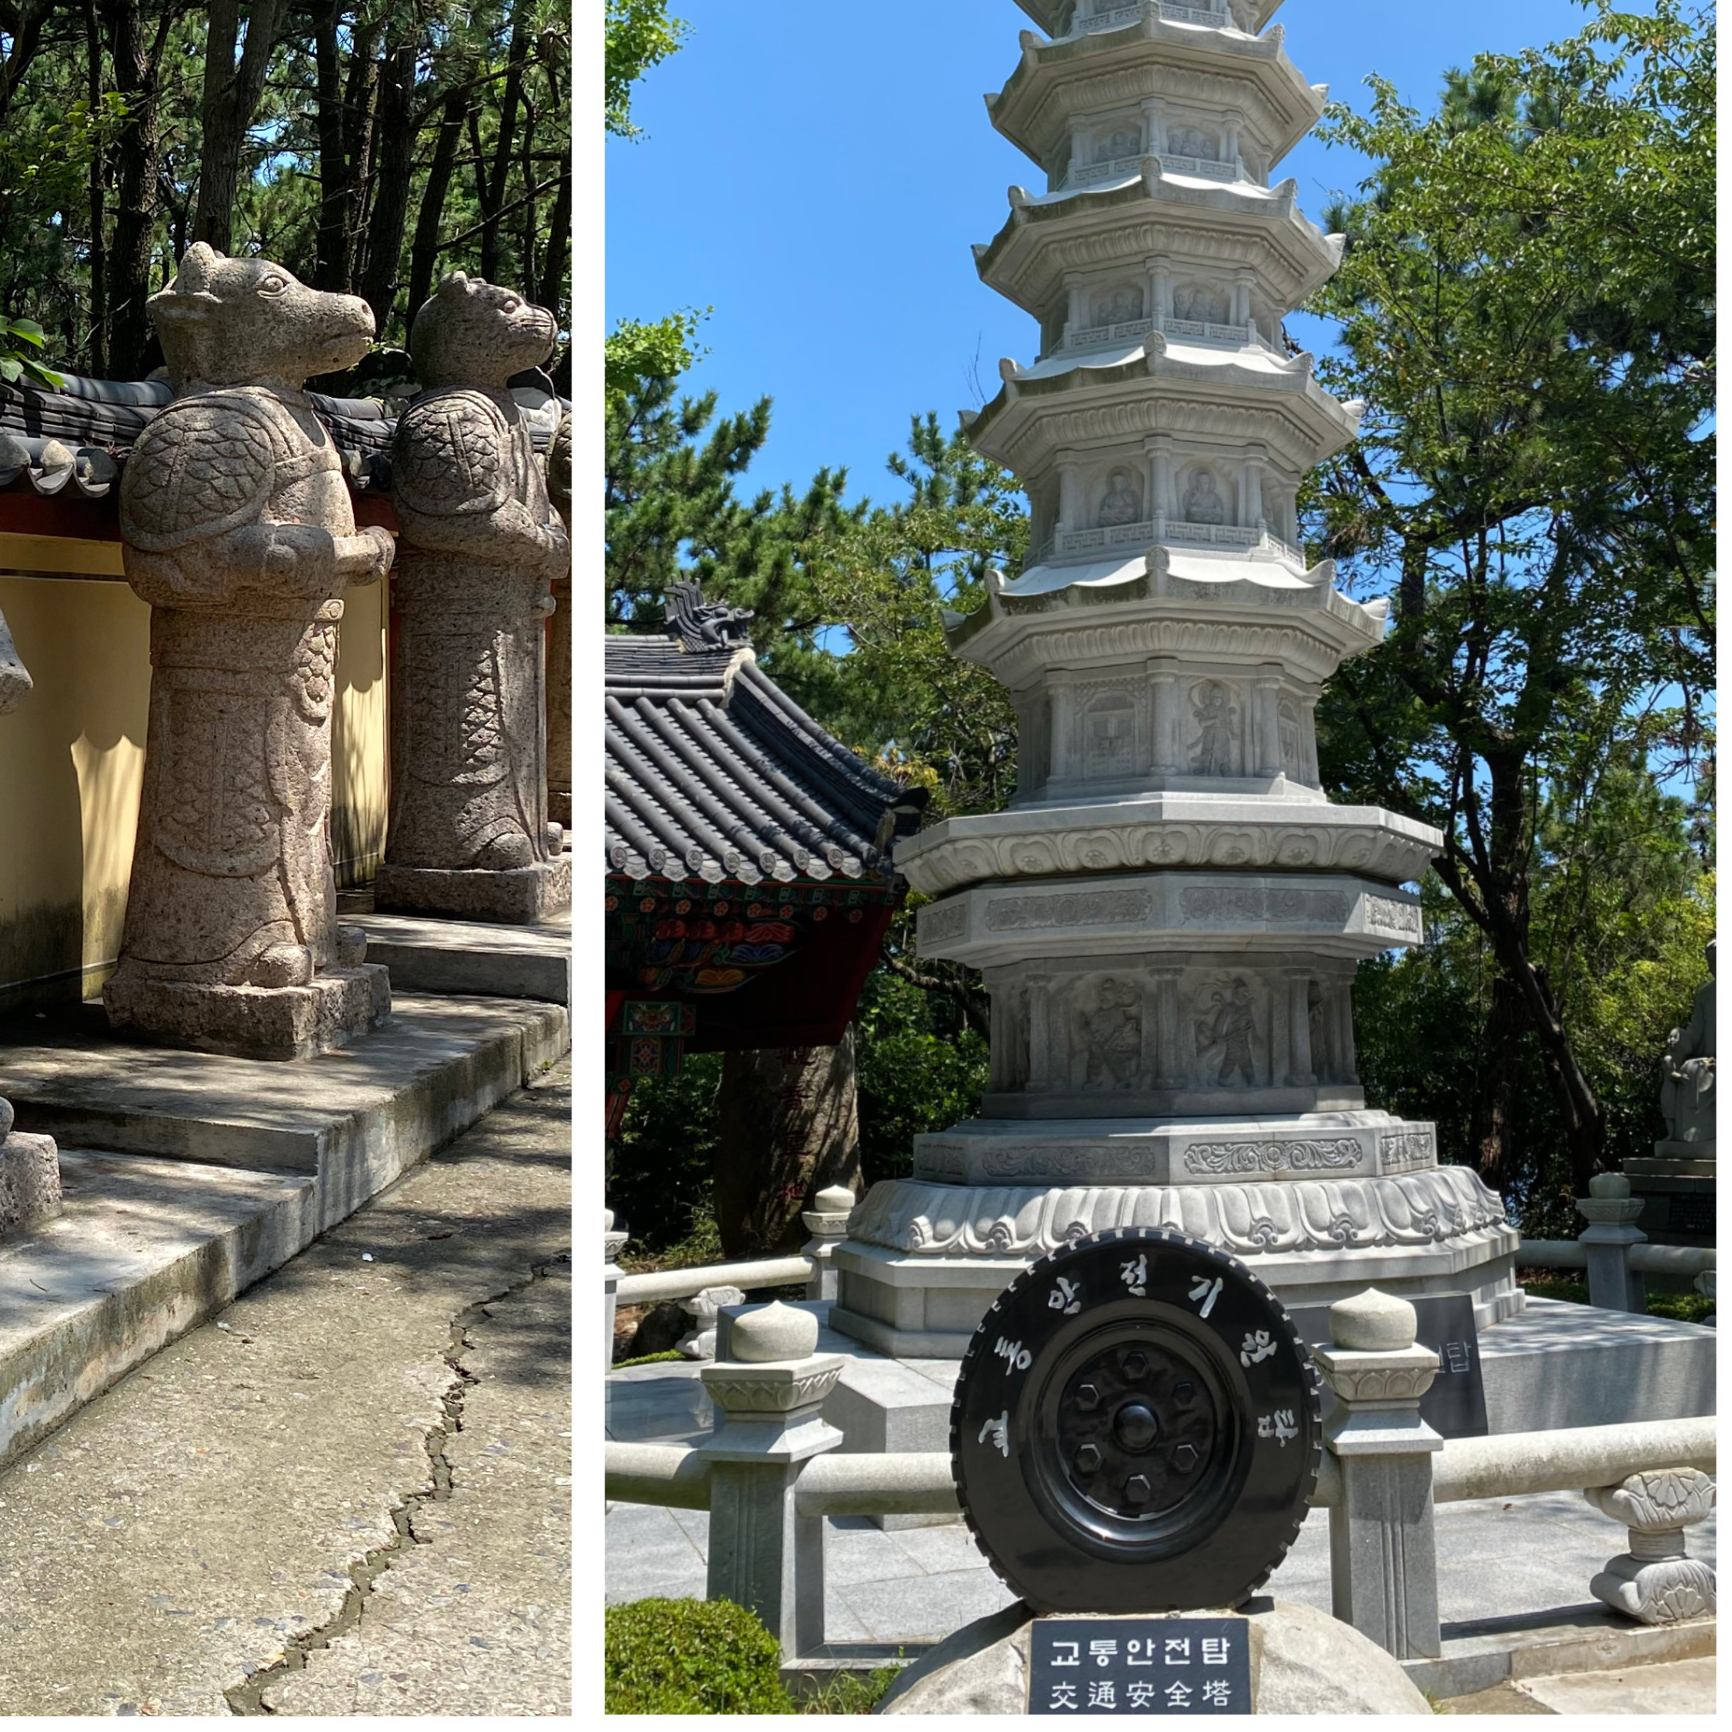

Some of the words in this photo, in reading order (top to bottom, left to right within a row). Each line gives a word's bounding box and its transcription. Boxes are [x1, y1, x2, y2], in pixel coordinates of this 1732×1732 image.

[1050, 1638, 1231, 1667] 교통안전탑
[1048, 1679, 1233, 1710] 交通安全塔
